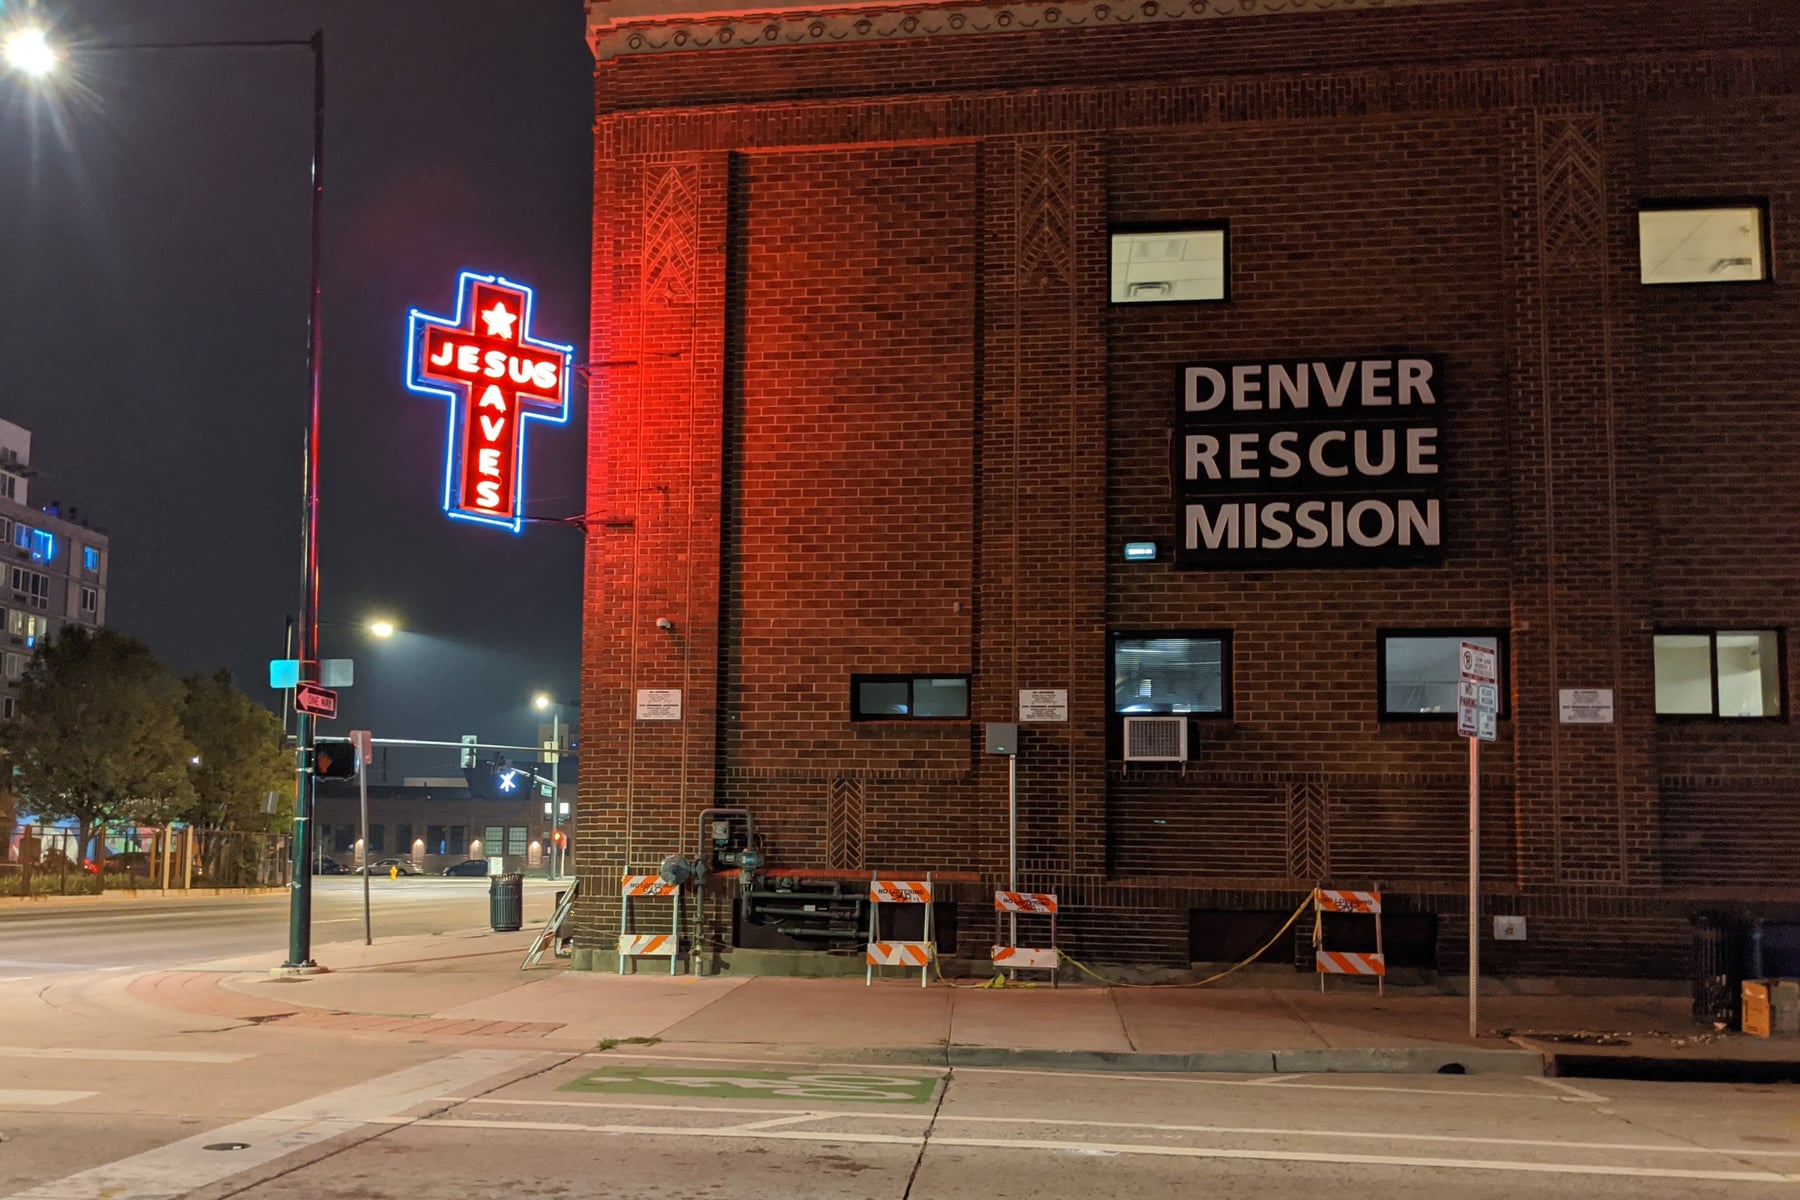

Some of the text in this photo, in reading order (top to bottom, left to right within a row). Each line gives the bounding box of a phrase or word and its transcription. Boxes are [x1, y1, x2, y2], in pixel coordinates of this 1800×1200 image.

[431, 342, 557, 389] JESUS
[1185, 359, 1436, 412] DENVER
[1185, 427, 1439, 481] RESCUE
[1185, 499, 1440, 550] MISSION
[308, 694, 333, 709] ONE WAY
